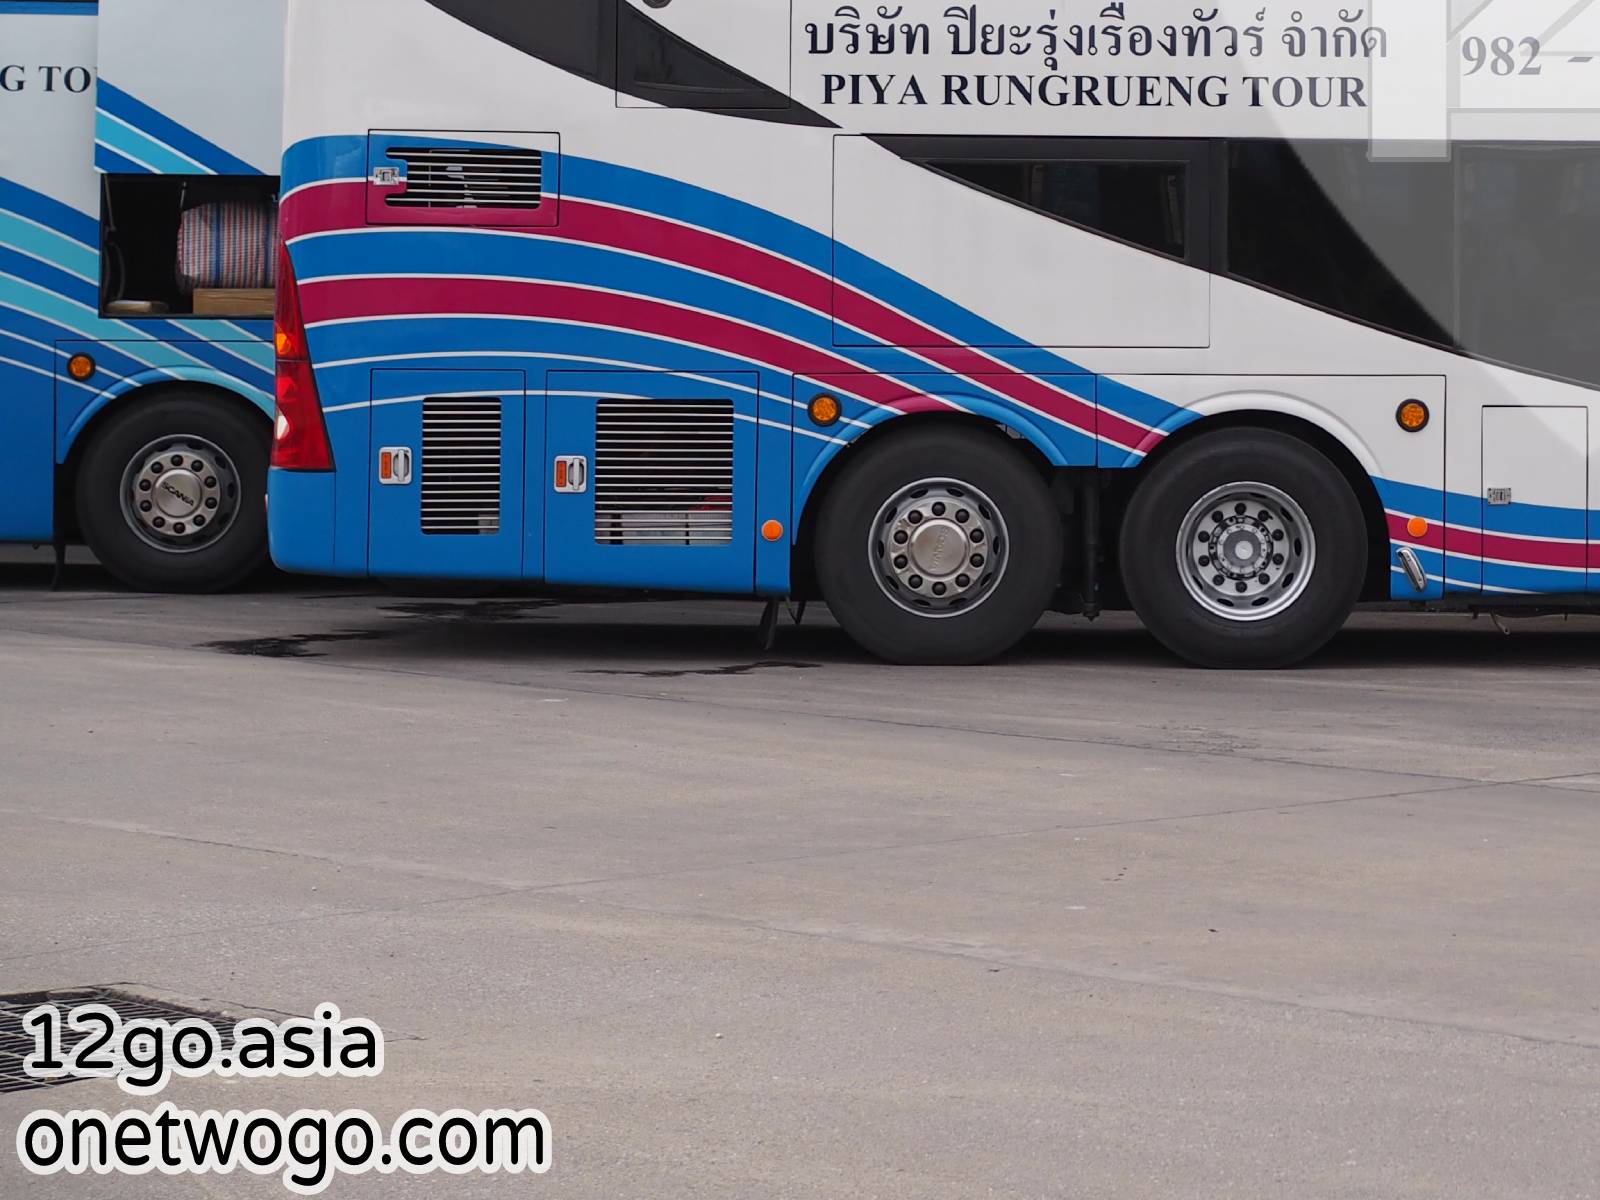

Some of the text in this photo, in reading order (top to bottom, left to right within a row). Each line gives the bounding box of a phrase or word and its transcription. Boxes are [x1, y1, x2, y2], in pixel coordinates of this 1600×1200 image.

[804, 1, 1389, 71] บริษัท ปิยะรุ่งเรืองทัวร์ จำกัด
[1461, 35, 1542, 77] 982
[38, 65, 97, 93] TO
[821, 73, 1369, 108] PIYA RUNGRUENG TOUR
[160, 480, 195, 507] SCANIA
